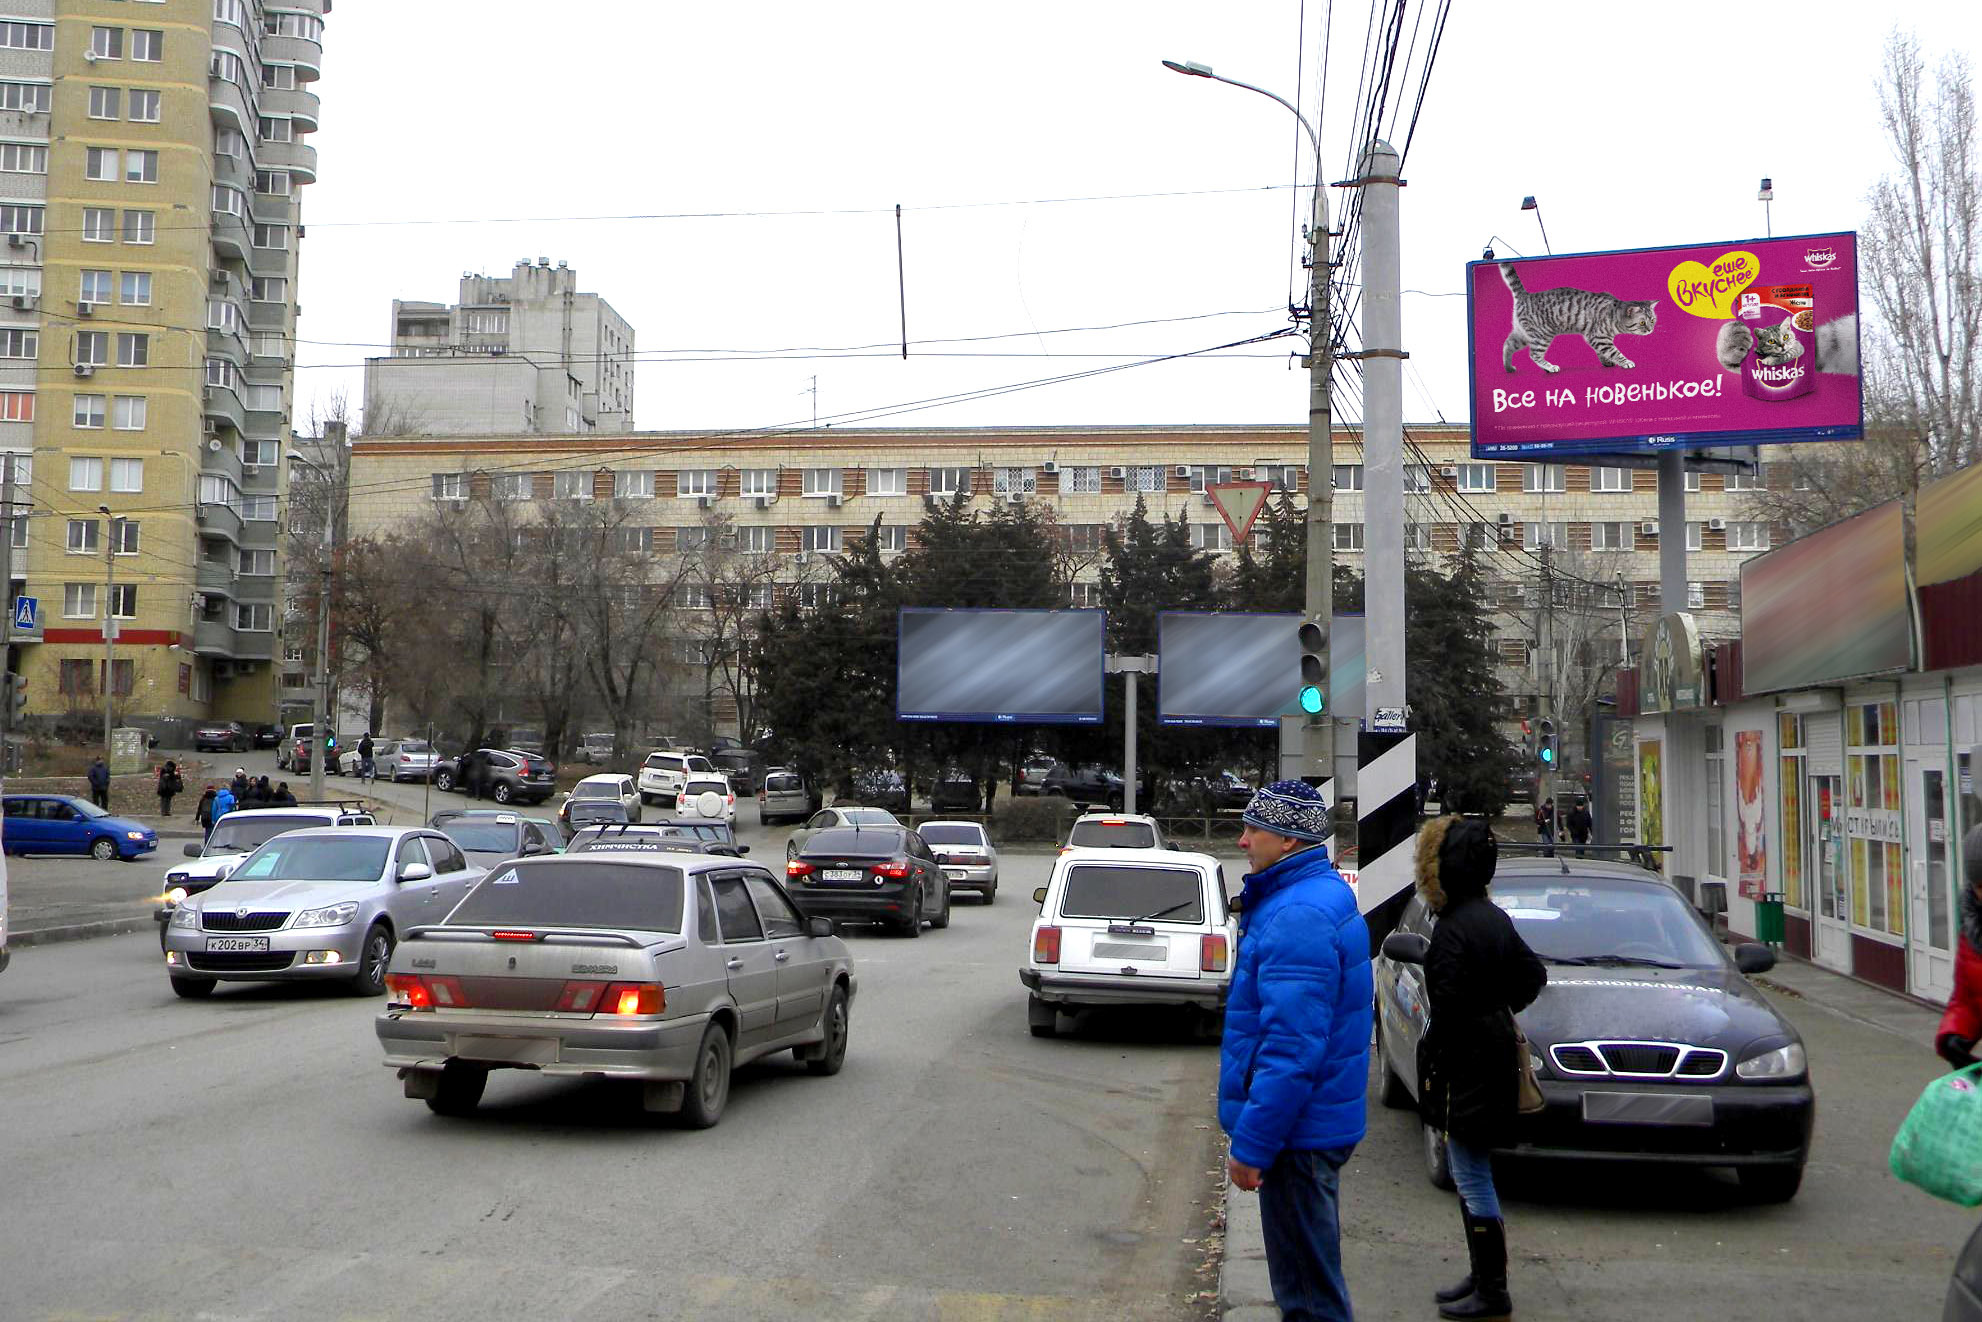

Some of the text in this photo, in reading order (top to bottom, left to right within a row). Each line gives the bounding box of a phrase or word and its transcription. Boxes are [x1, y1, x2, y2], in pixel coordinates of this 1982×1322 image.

[1804, 252, 1837, 262] whiskas
[1744, 295, 1756, 303] 1+
[1752, 366, 1805, 381] whiskas
[1492, 388, 1536, 413] Все
